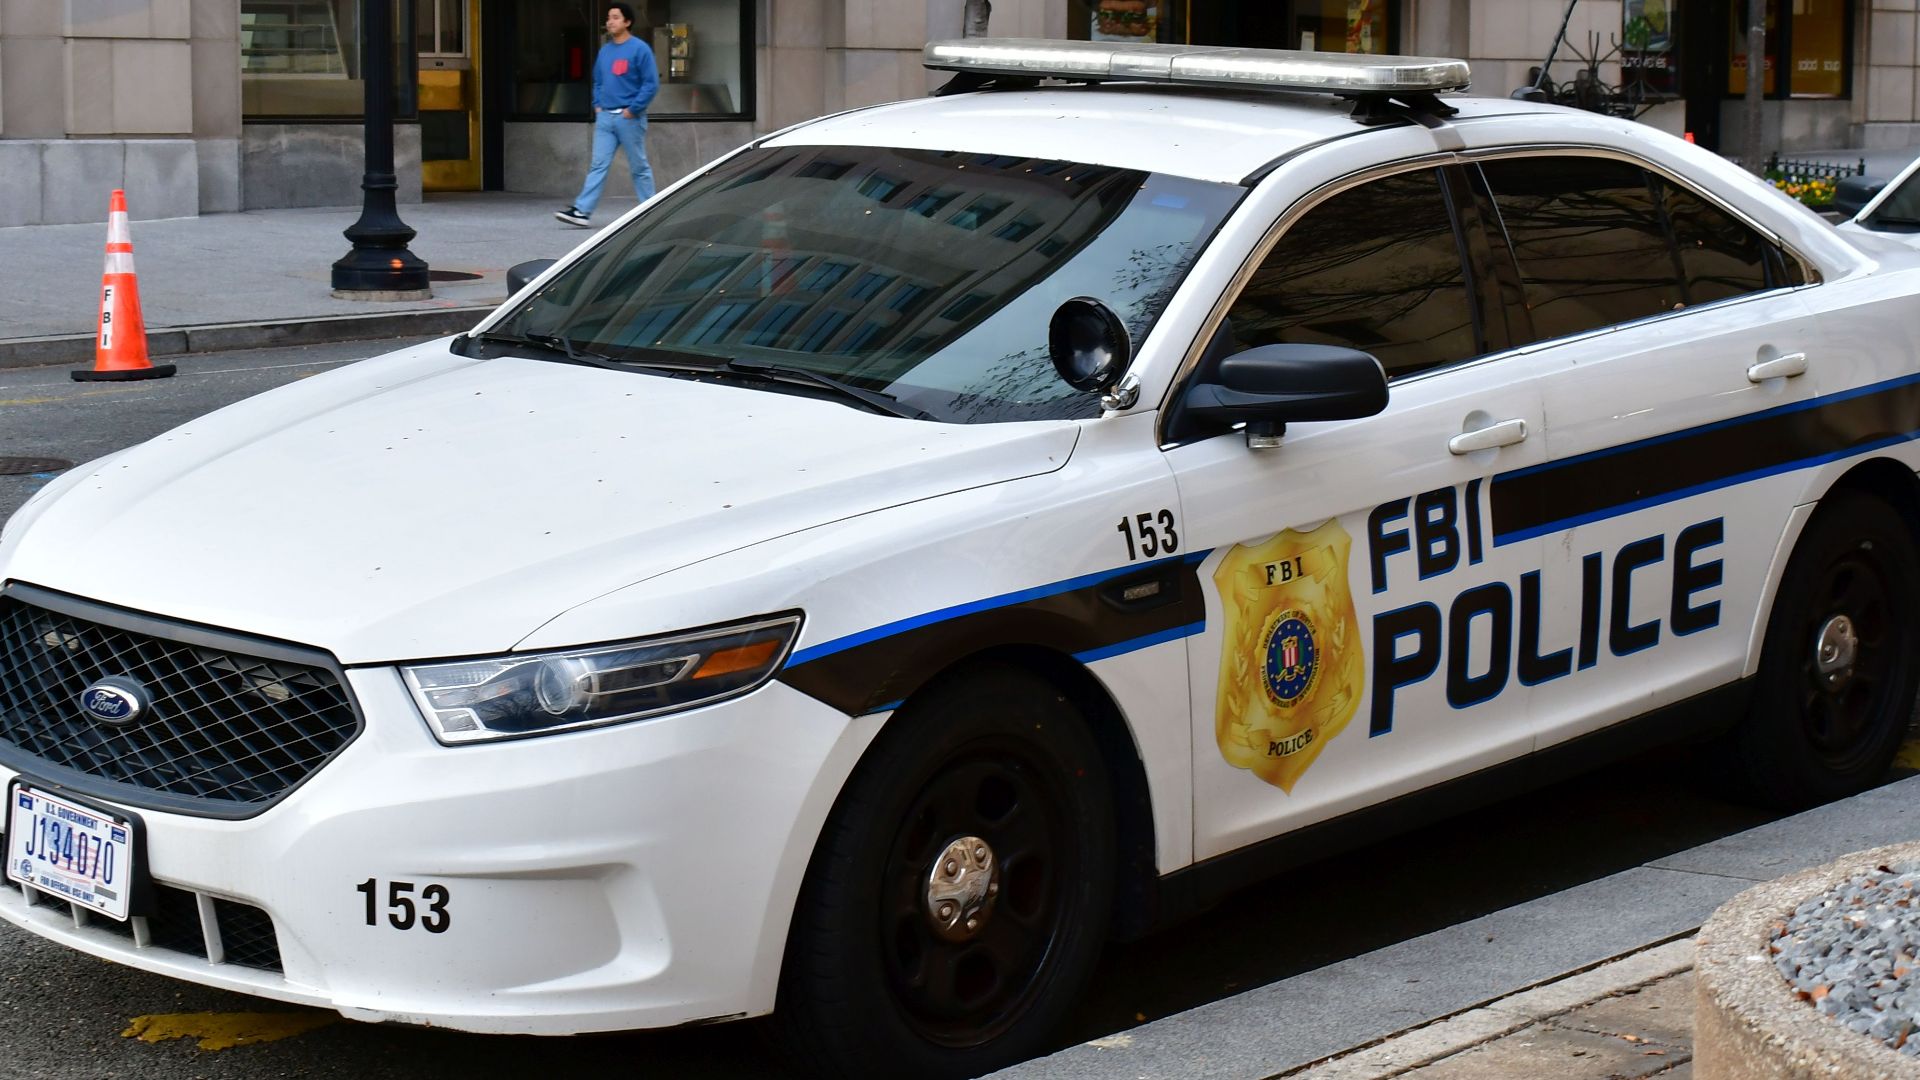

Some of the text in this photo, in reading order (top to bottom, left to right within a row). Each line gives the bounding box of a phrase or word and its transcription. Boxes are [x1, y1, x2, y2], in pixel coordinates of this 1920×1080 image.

[103, 289, 112, 346] FBI
[1117, 509, 1178, 561] 153
[1367, 477, 1484, 595] FBI
[1265, 556, 1303, 586] FBI
[1368, 516, 1724, 738] POLICE
[90, 690, 123, 714] Ford
[1267, 728, 1313, 757] POLICE
[58, 806, 98, 830] GOVERNMENT
[25, 814, 114, 885] J134070
[356, 877, 451, 934] 153
